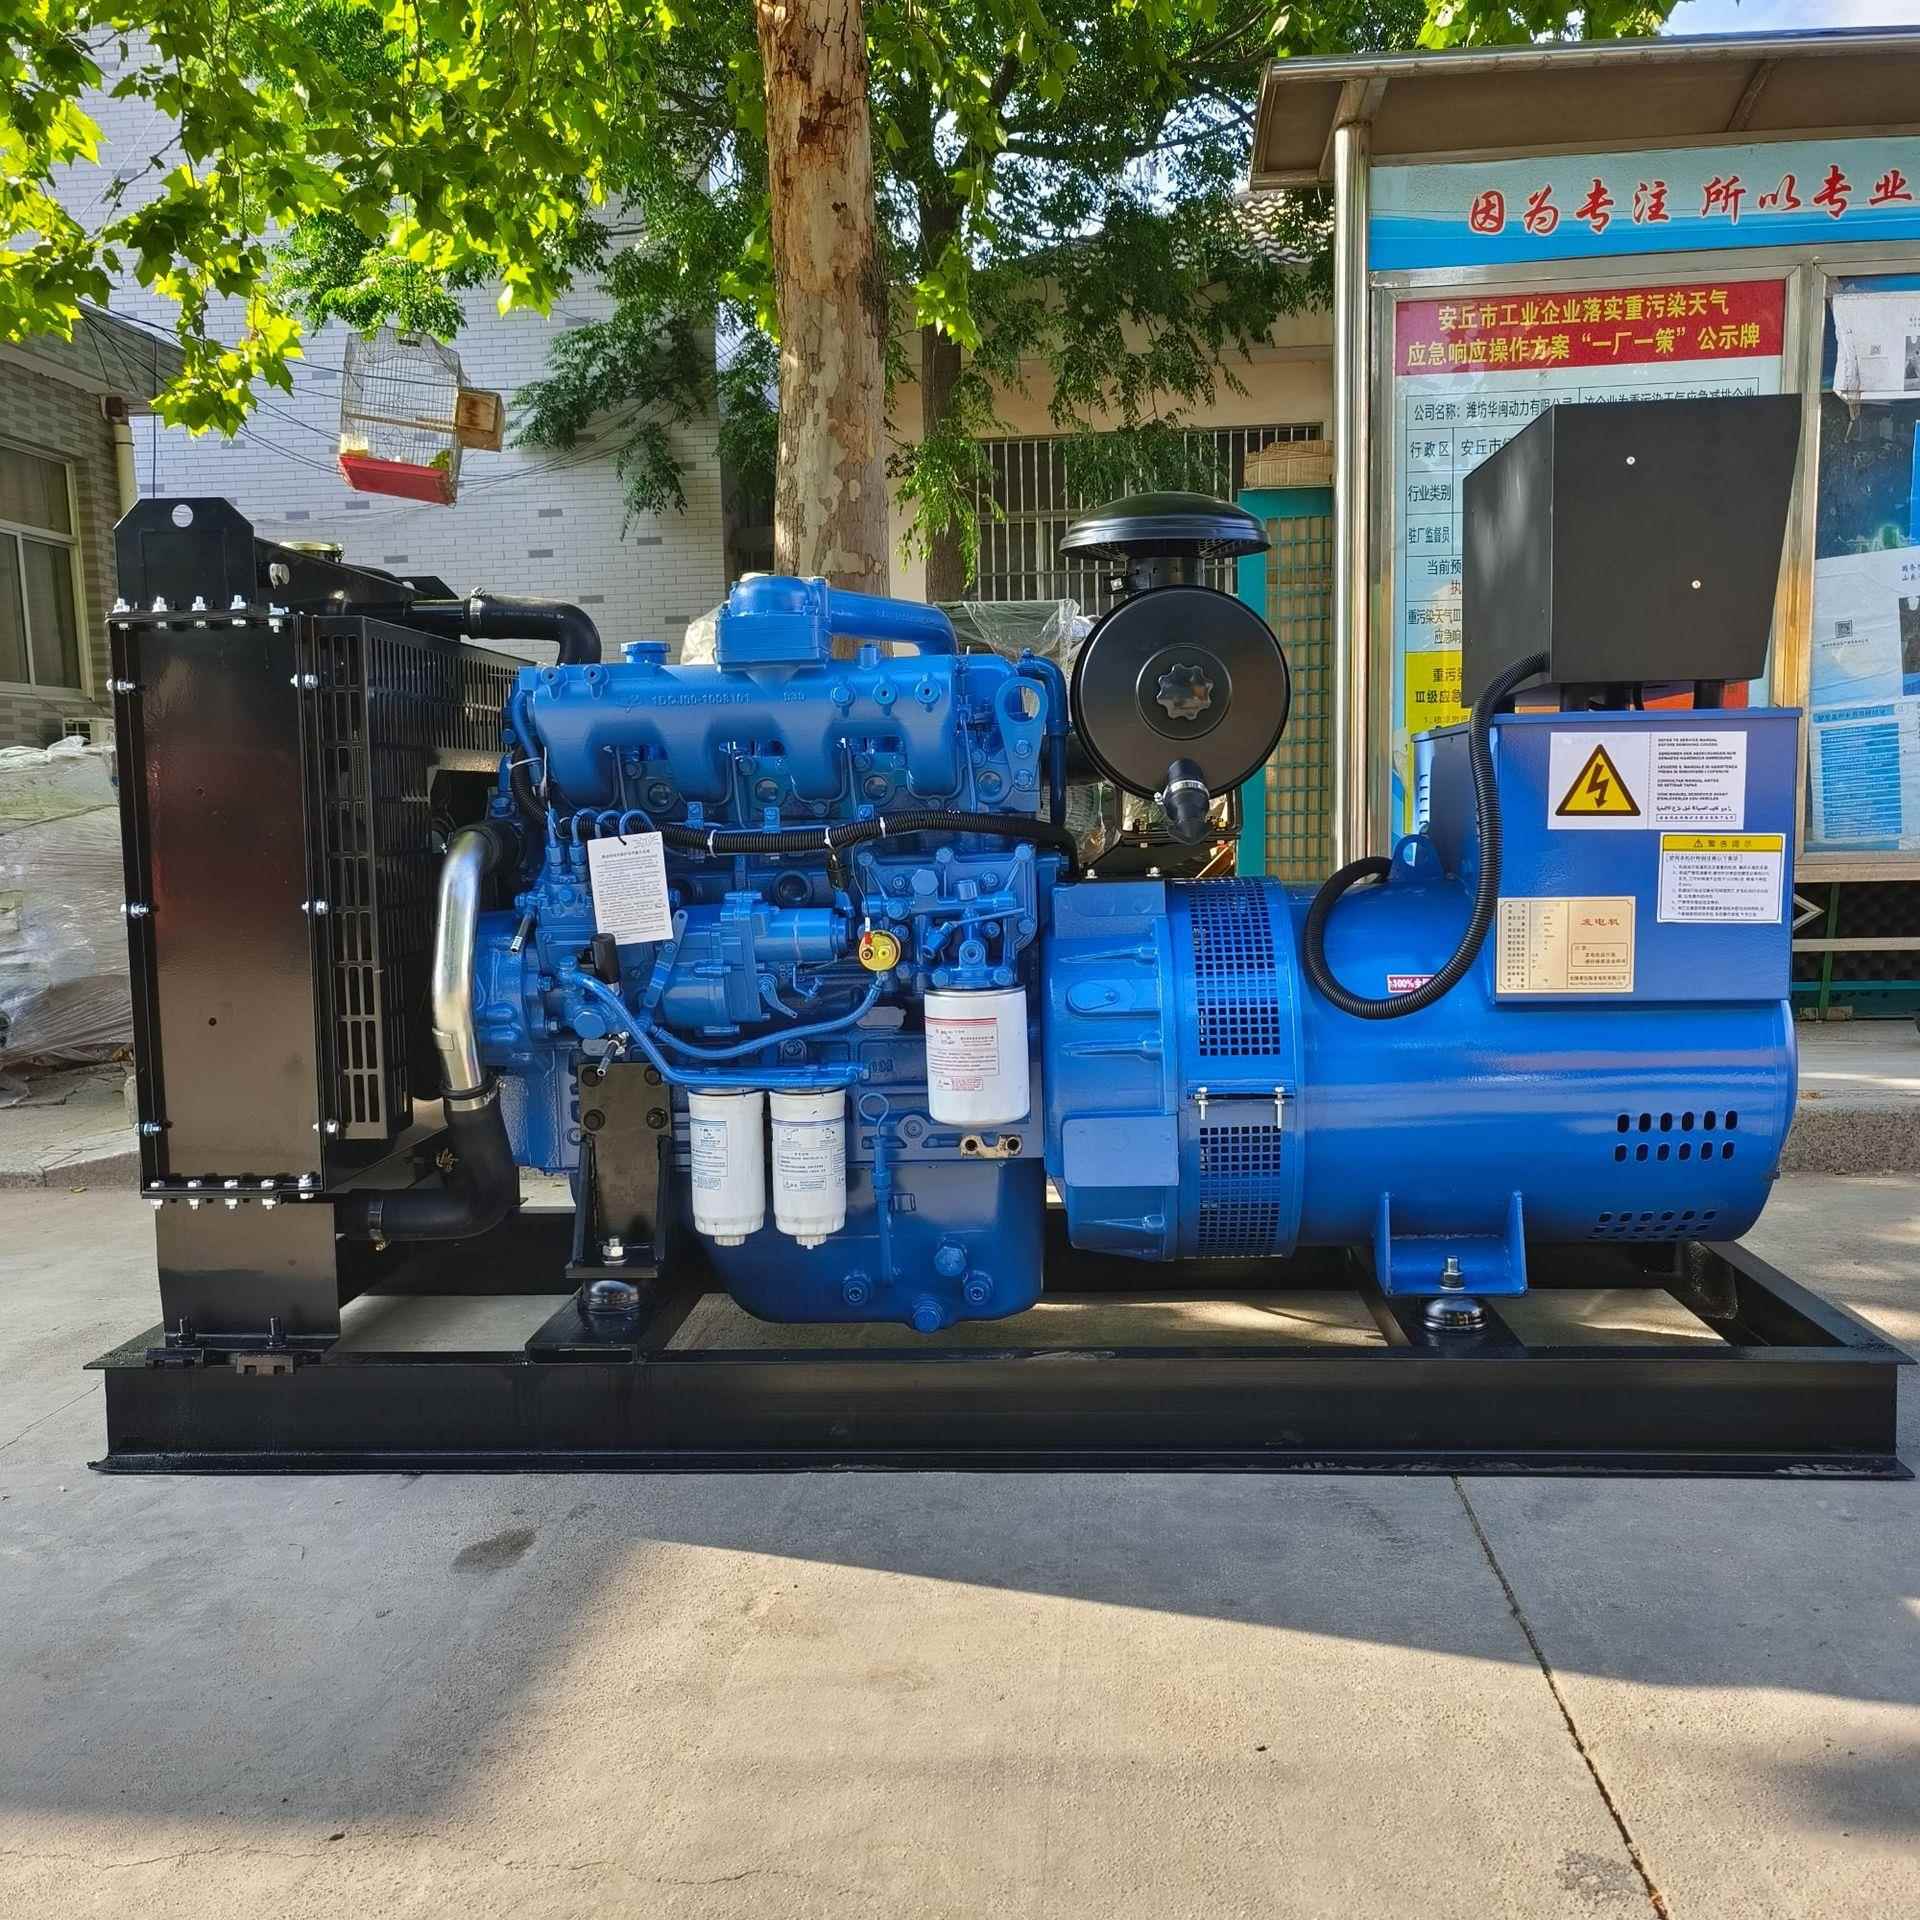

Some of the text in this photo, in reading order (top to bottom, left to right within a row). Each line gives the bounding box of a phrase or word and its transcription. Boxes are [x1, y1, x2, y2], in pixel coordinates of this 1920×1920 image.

[1468, 164, 1913, 235] 因为专注 所以专业
[1438, 289, 1730, 332] 安丘市工业企业落实重污染天气
[1410, 440, 1450, 459] 行政区
[1408, 484, 1451, 503] 行业类别
